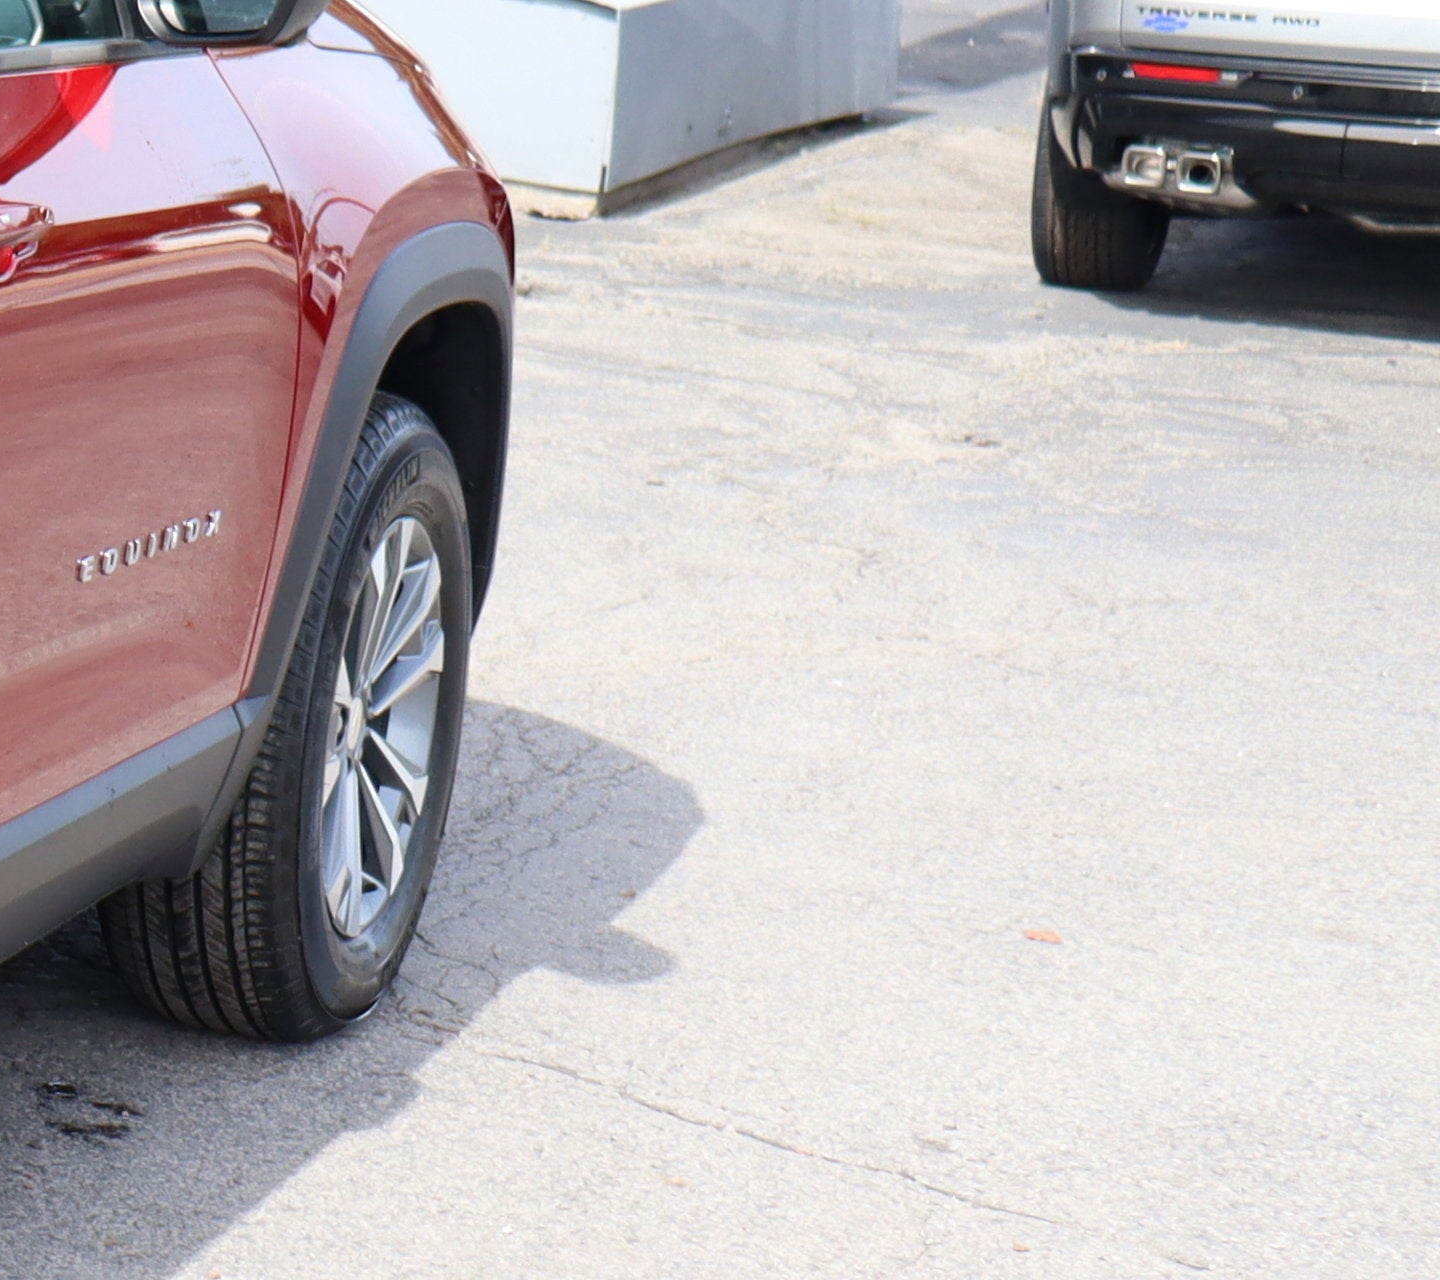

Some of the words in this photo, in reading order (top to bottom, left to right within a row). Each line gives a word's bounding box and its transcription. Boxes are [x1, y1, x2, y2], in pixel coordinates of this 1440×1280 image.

[1135, 4, 1259, 24] TRAVERSE
[1271, 14, 1322, 29] AWD
[75, 508, 223, 583] EQUINOX
